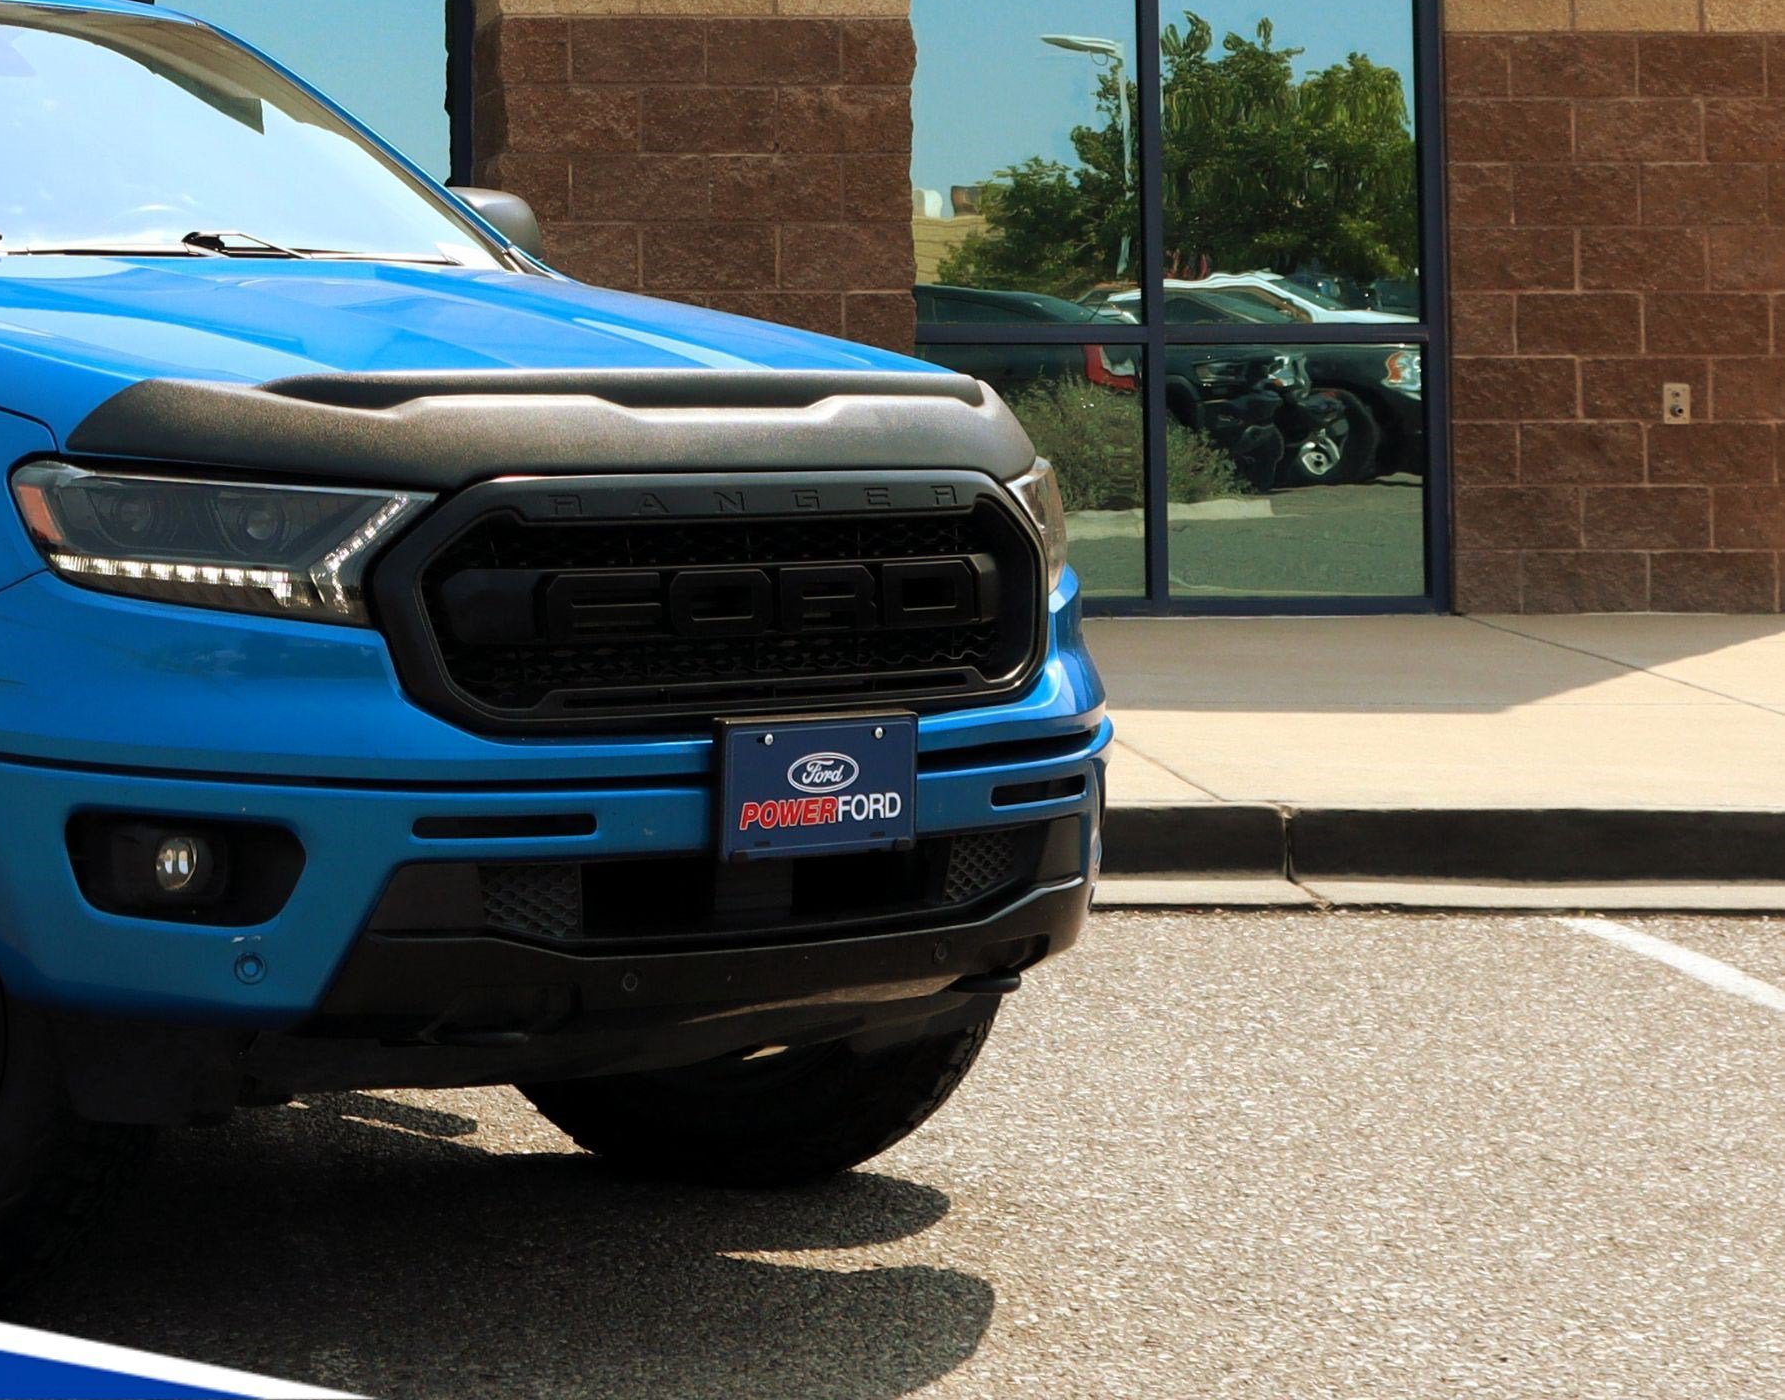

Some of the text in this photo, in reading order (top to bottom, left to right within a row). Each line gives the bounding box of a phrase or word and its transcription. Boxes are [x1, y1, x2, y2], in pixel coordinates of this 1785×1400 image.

[546, 484, 960, 516] RANGER
[543, 560, 977, 641] FORD
[801, 758, 845, 785] Ford
[739, 791, 902, 831] POWERFORD
